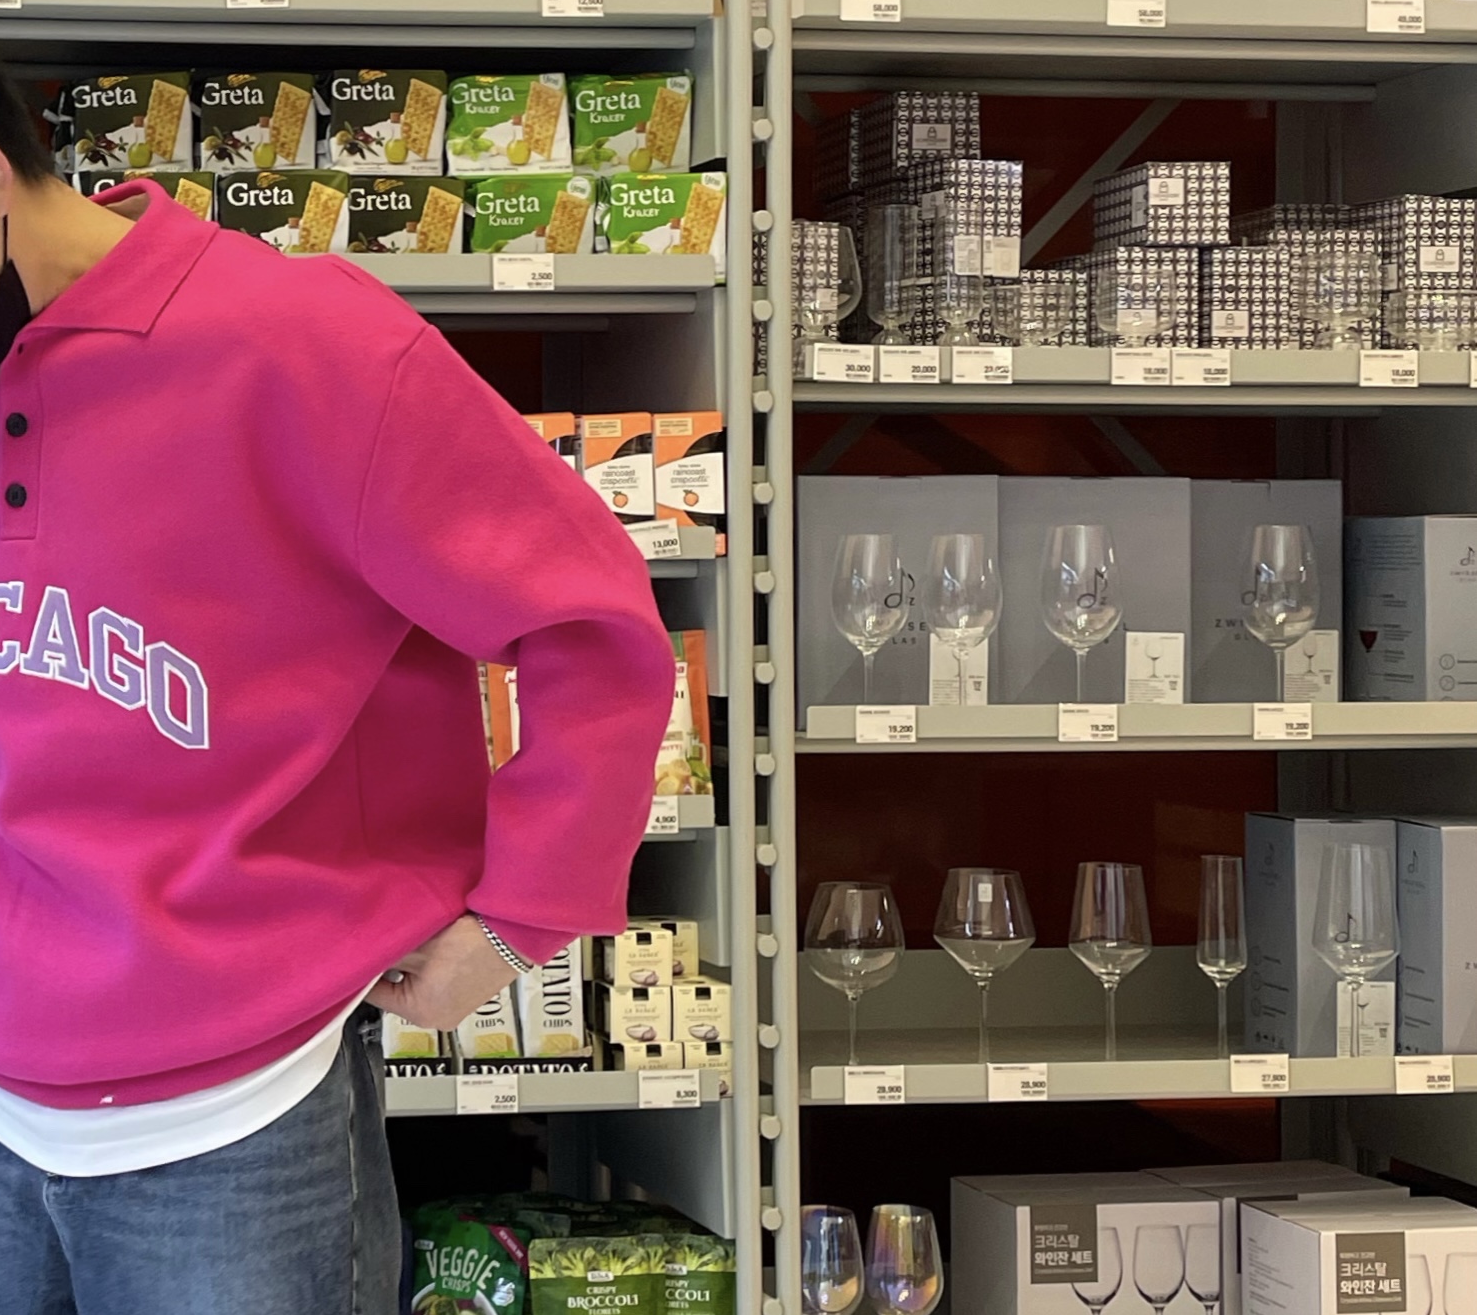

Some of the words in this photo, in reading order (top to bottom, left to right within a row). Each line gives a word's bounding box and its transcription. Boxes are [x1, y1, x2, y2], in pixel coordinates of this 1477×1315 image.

[72, 85, 138, 109] Greta
[201, 82, 265, 106] Greta
[331, 77, 396, 102] Greta
[451, 83, 516, 106] Greta
[464, 102, 501, 115] Kraker
[575, 90, 642, 113] Greta
[589, 111, 626, 125] Kraker
[226, 181, 295, 207] Greta
[348, 188, 413, 211] Greta
[609, 184, 676, 207] Greta
[475, 193, 541, 216] Greta
[622, 205, 661, 219] Kraker
[488, 213, 526, 228] Kraker
[494, 1094, 517, 1104] 2,500
[1034, 1234, 1080, 1249] 크리스탈
[1034, 1250, 1069, 1266] 와인잔
[1071, 1250, 1094, 1265] 세트
[425, 1245, 501, 1291] VEGGIE
[1339, 1262, 1387, 1277] 크리스탈
[442, 1276, 472, 1293] CRISPS
[586, 1285, 618, 1295] CRISPY
[1339, 1279, 1376, 1295] 와인잔
[1377, 1278, 1402, 1293] 세트
[567, 1293, 639, 1310] BROCCOLI
[665, 1289, 711, 1302] CCOLI
